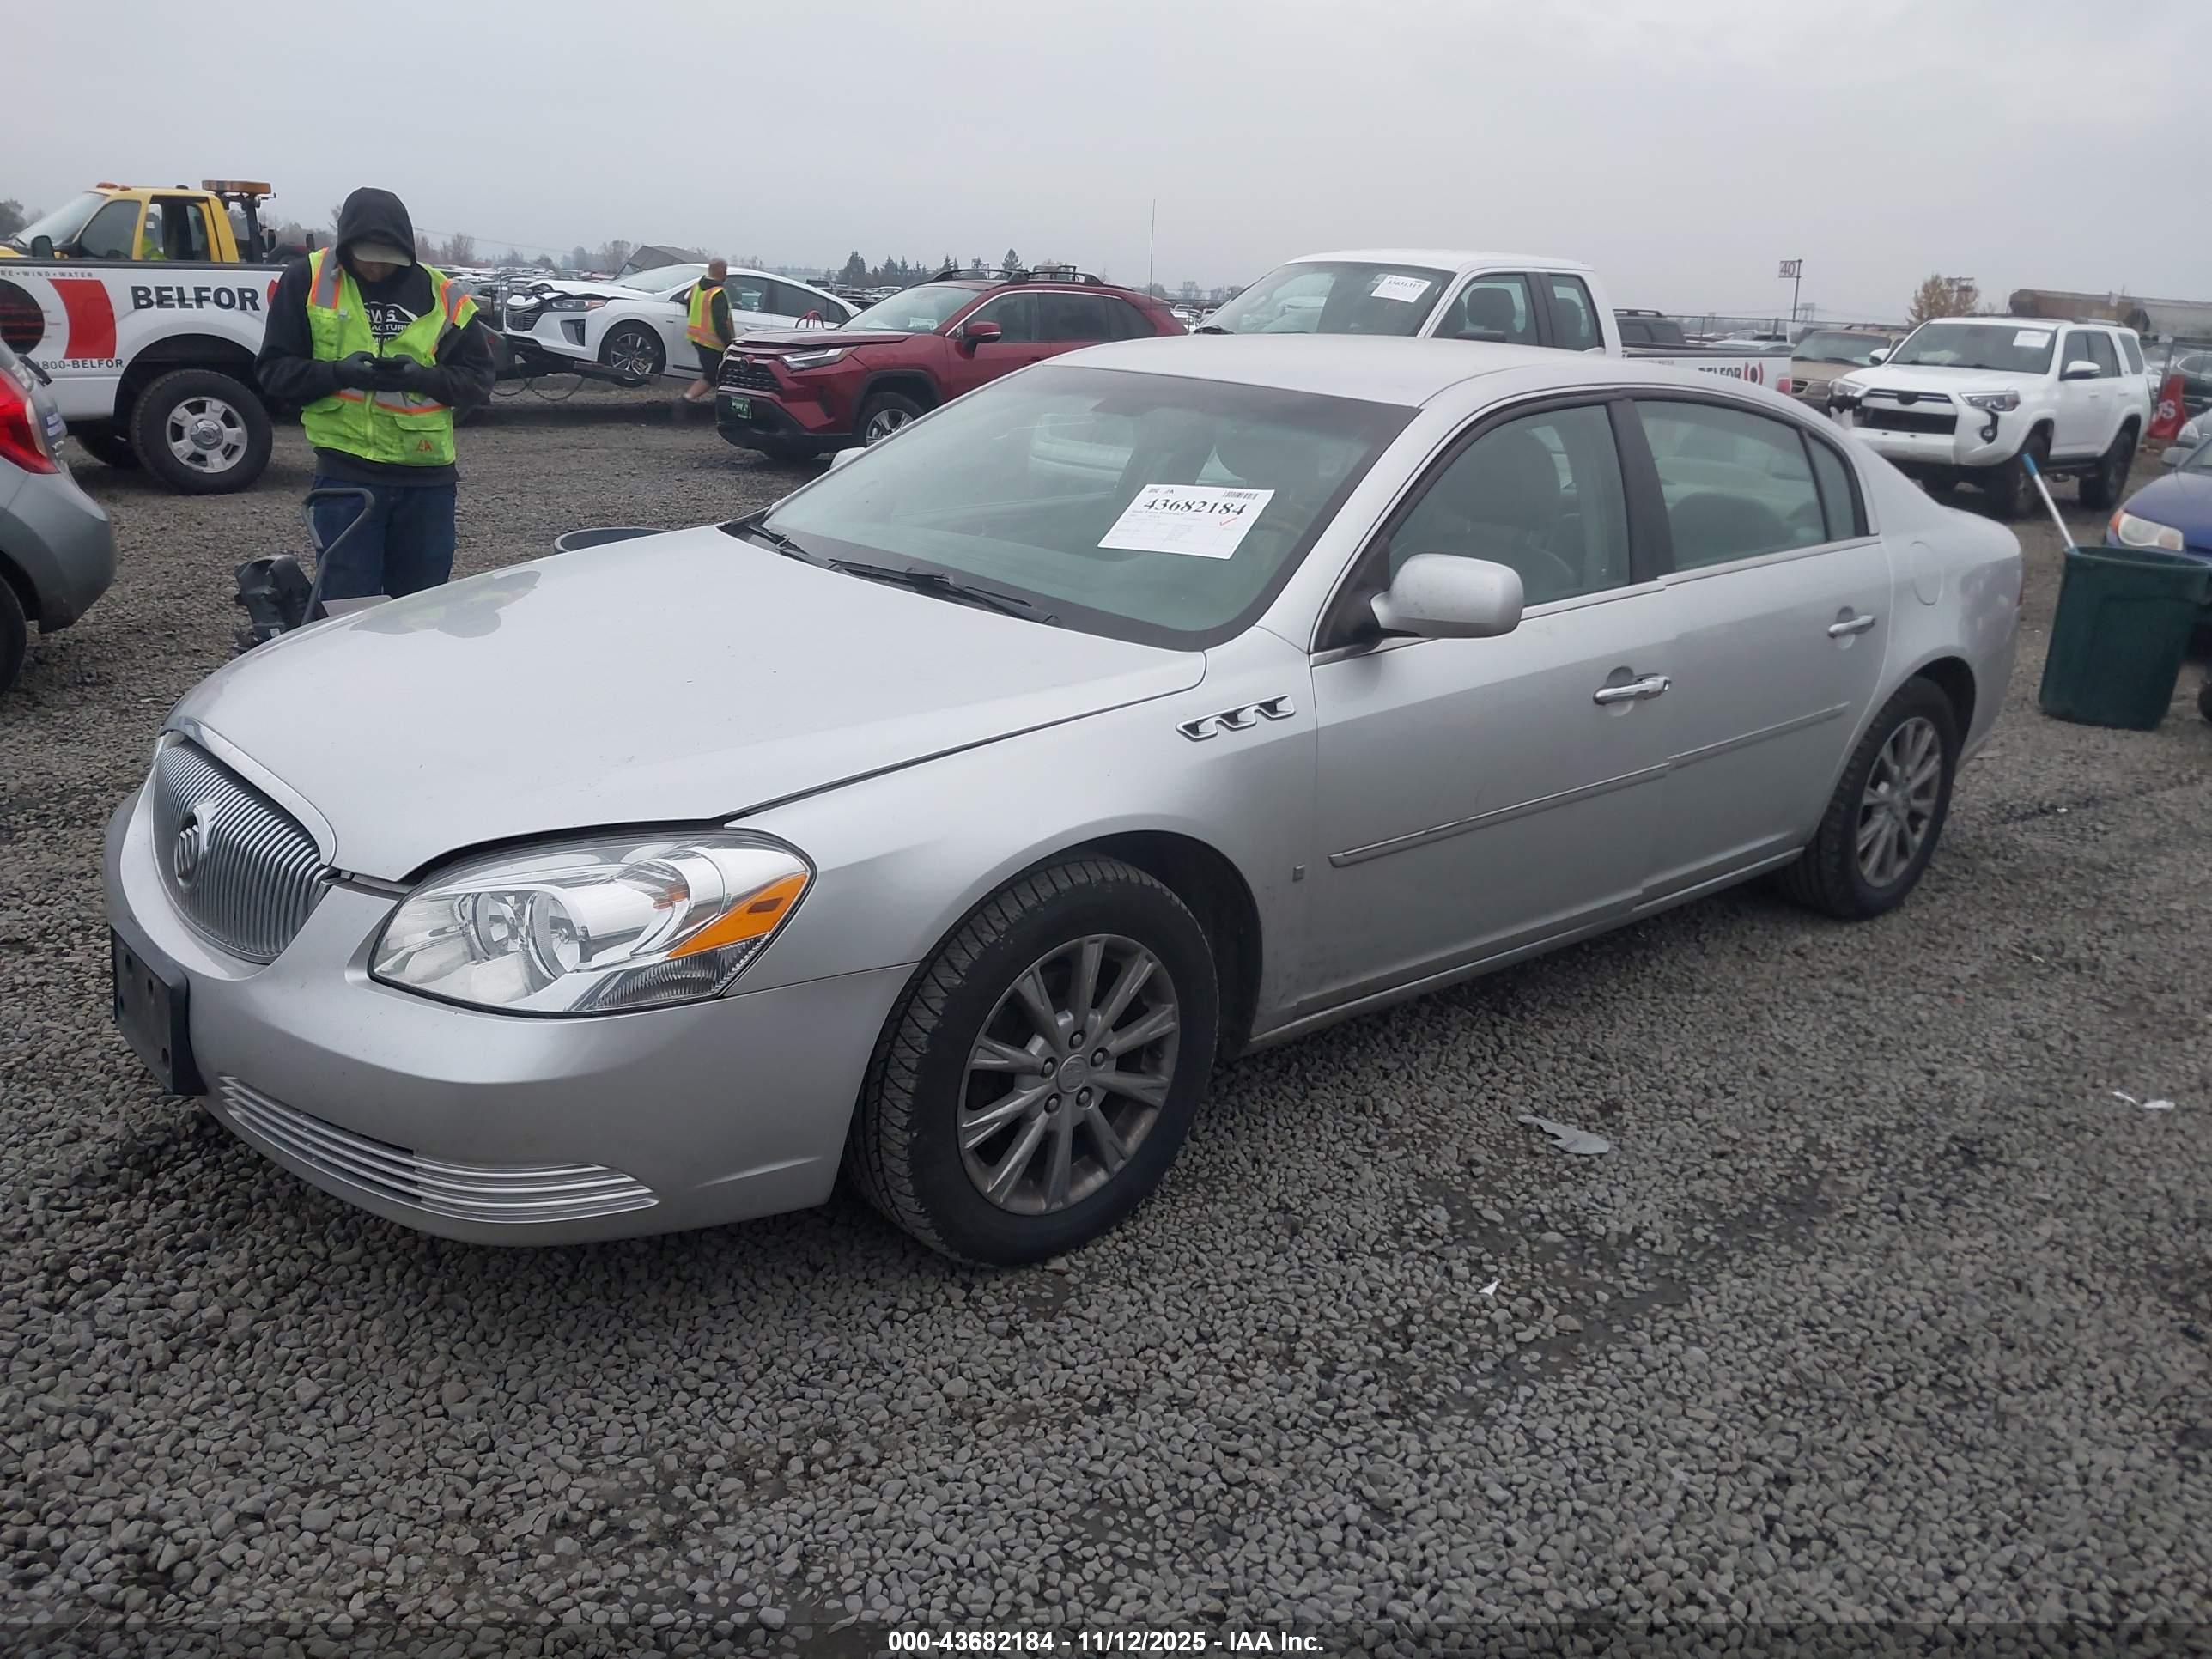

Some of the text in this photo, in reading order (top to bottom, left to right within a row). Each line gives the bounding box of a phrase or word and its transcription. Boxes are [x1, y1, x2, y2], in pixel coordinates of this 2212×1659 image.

[1780, 261, 1796, 276] 40
[131, 286, 261, 312] BELFOR
[1144, 498, 1248, 516] 43682184
